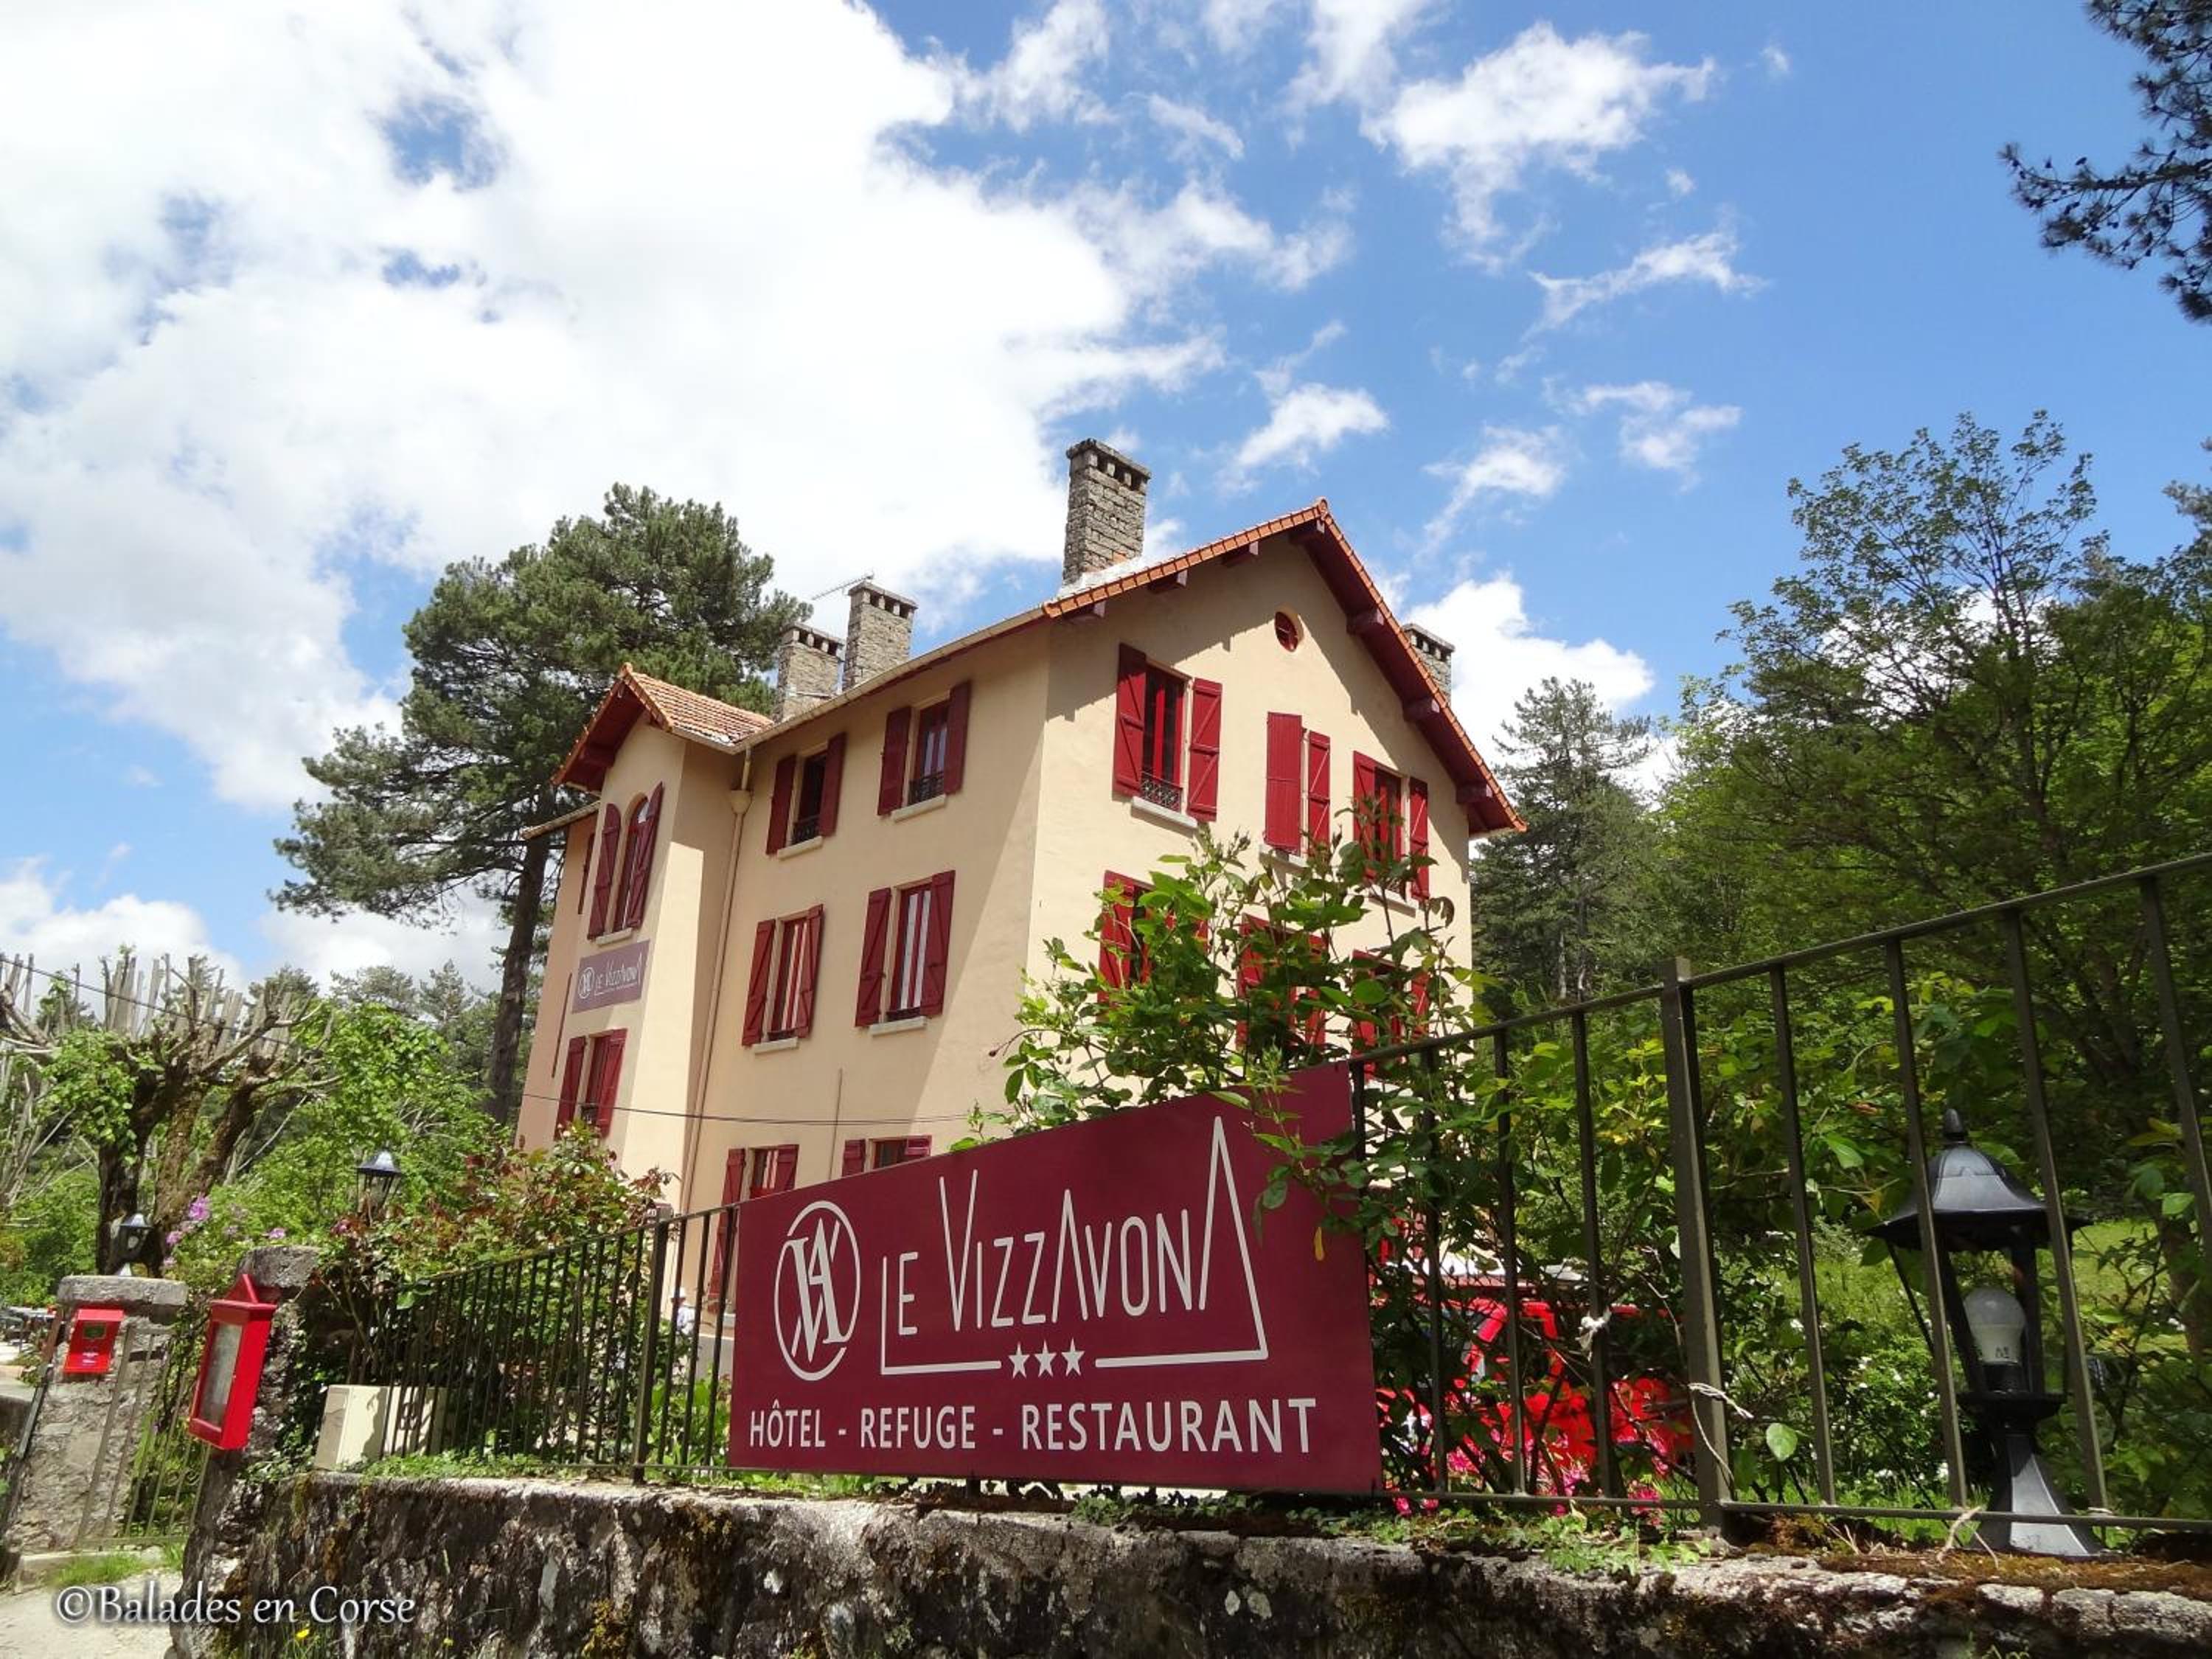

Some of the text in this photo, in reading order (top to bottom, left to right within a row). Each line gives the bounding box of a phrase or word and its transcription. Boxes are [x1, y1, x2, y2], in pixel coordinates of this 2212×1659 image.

[881, 1116, 1268, 1357] LE VIZZAVONA
[750, 1399, 825, 1447] HÔTEL
[860, 1405, 975, 1449] REFUGE
[1022, 1398, 1316, 1453] RESTAURANT
